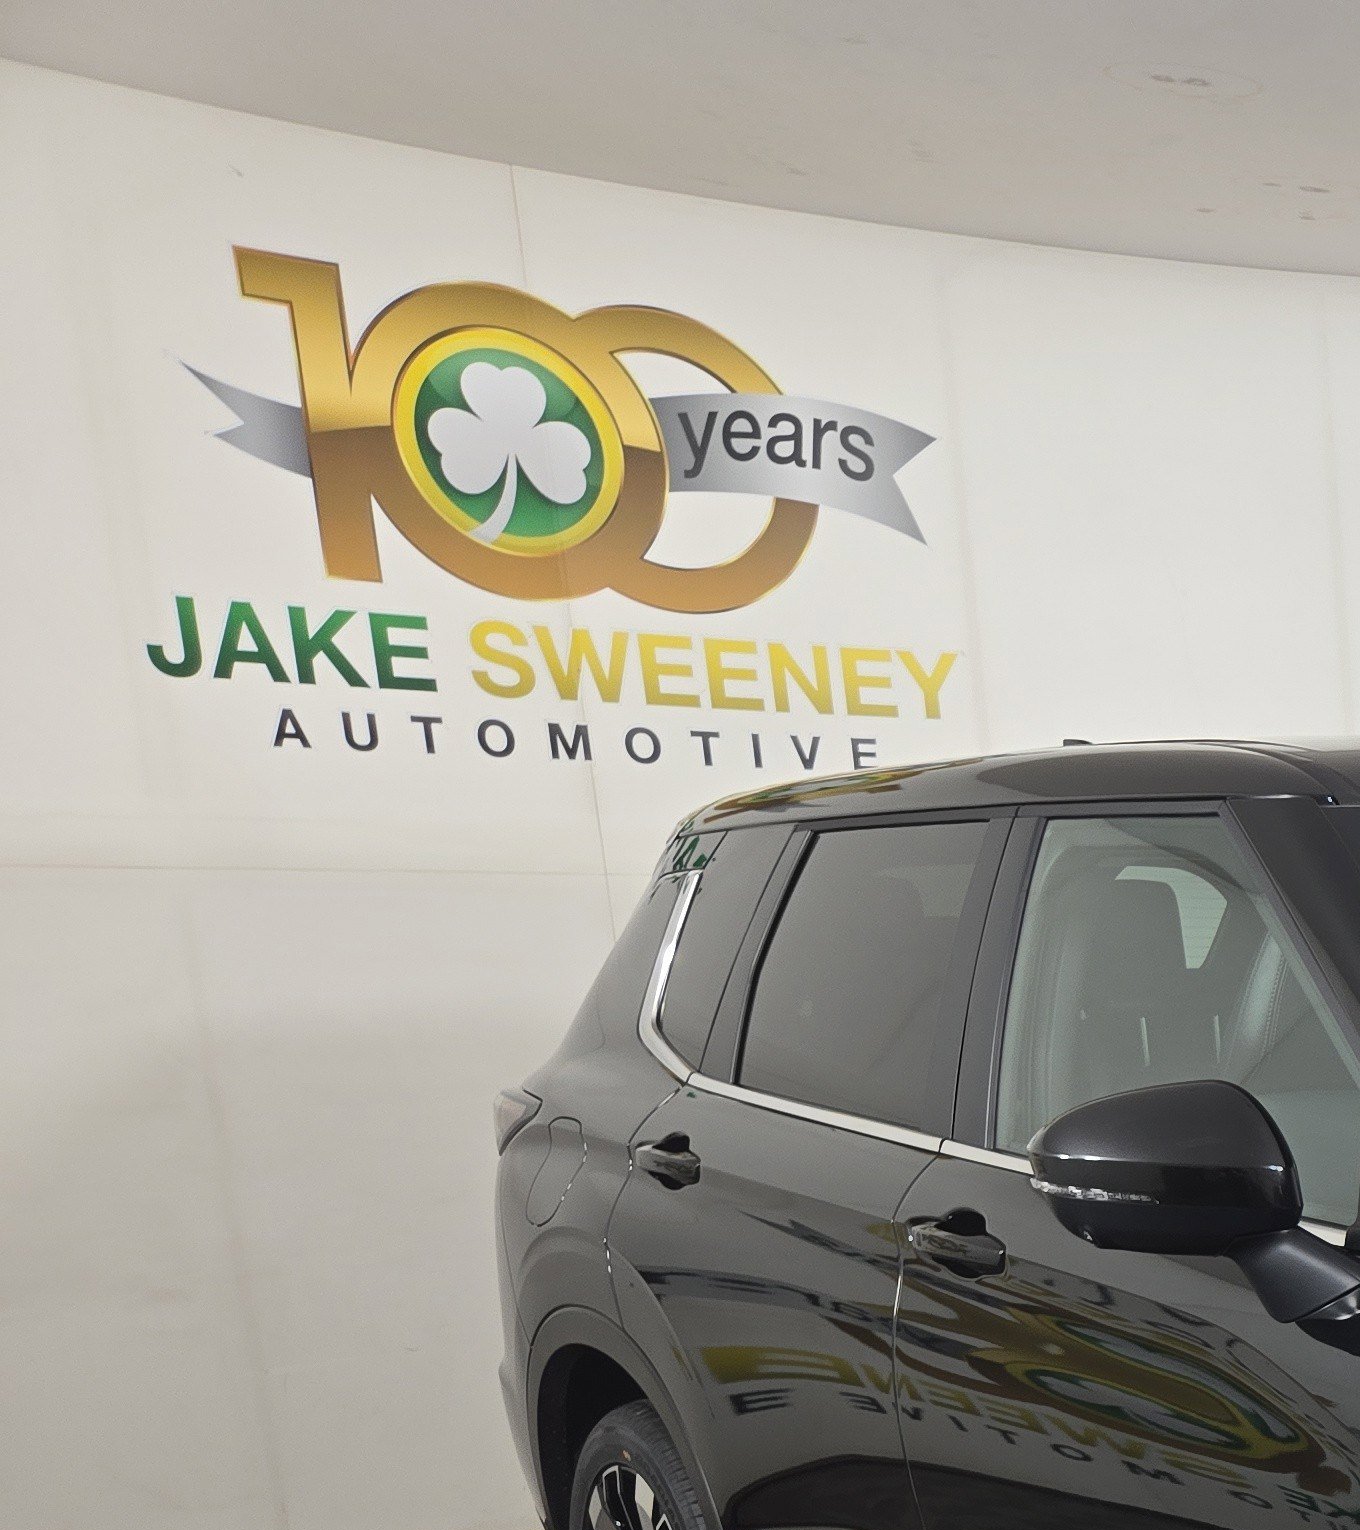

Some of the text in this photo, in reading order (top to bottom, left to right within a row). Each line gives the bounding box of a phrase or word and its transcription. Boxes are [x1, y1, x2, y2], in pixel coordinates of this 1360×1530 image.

[677, 405, 876, 483] years
[146, 595, 959, 720] JAKE SWEENEY
[274, 708, 878, 770] AUTOMOTIVE
